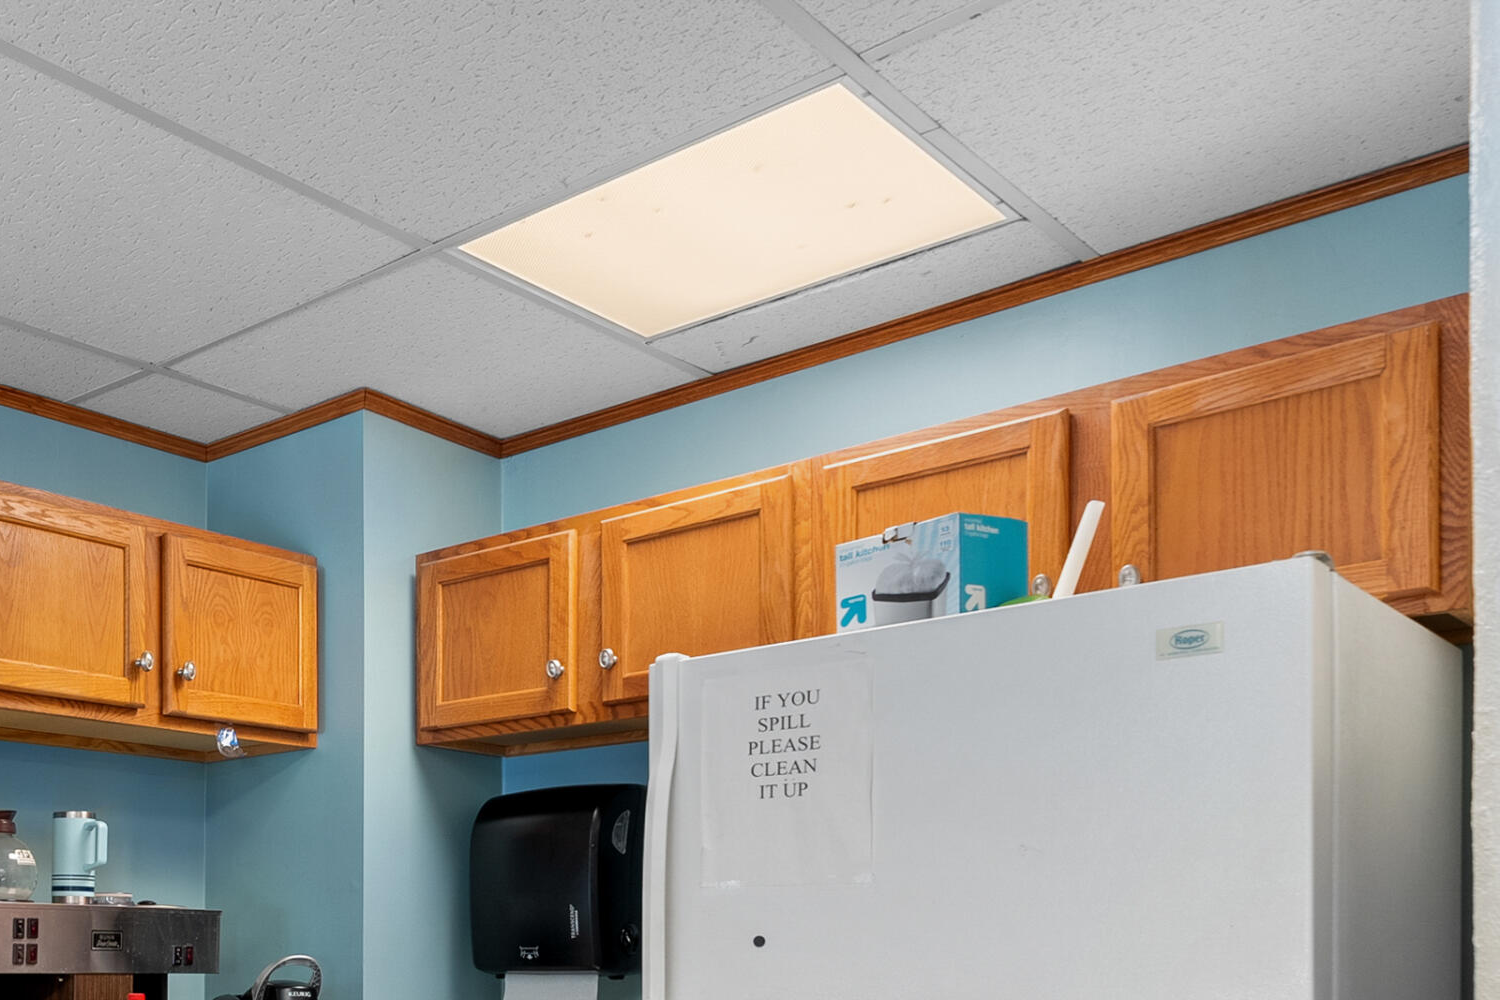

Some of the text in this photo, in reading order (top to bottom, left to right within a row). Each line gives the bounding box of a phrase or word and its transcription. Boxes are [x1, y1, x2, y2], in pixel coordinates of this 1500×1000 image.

[755, 689, 820, 711] IF YOU
[758, 714, 811, 732] SPILL
[748, 735, 821, 756] PLEASE
[751, 758, 817, 777] CLEAN
[760, 782, 808, 799] IT UP
